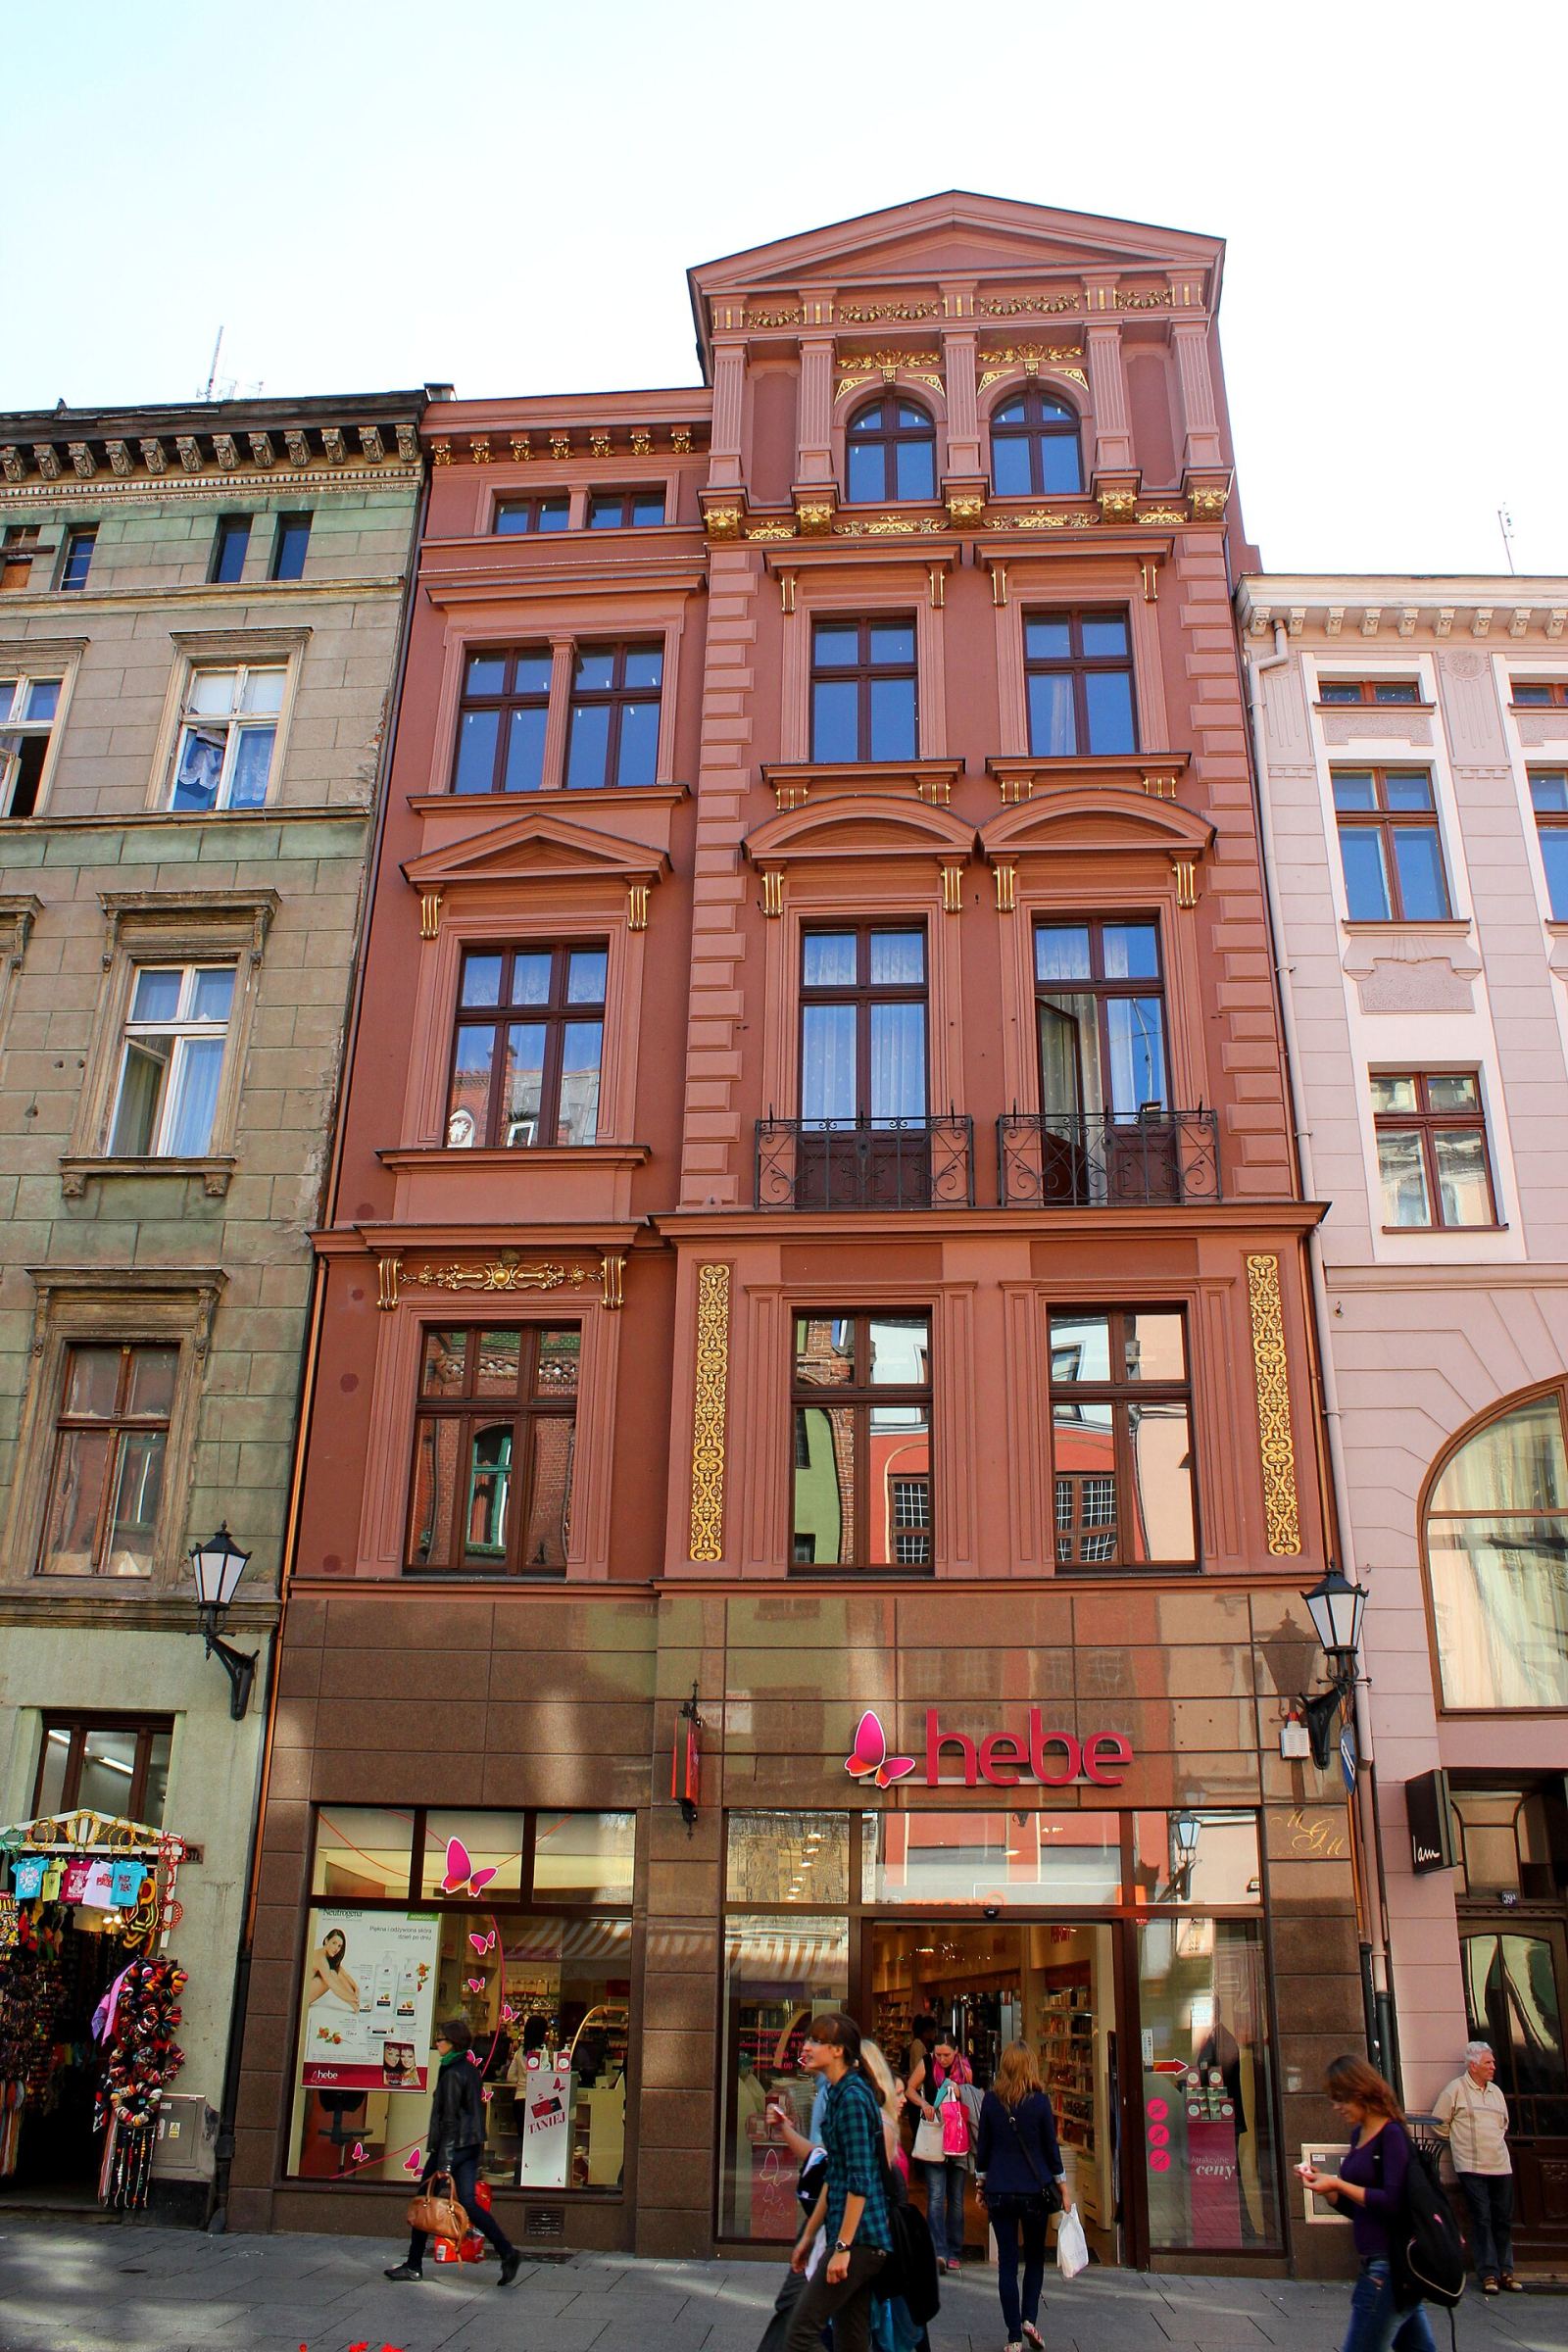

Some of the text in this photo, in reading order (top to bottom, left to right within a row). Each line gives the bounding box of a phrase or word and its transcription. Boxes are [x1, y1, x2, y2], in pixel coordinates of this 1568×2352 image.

[926, 1708, 1134, 1787] hebe
[318, 2069, 338, 2080] hebe
[528, 2112, 565, 2133] TANIEJ
[1196, 2165, 1236, 2180] ceny
